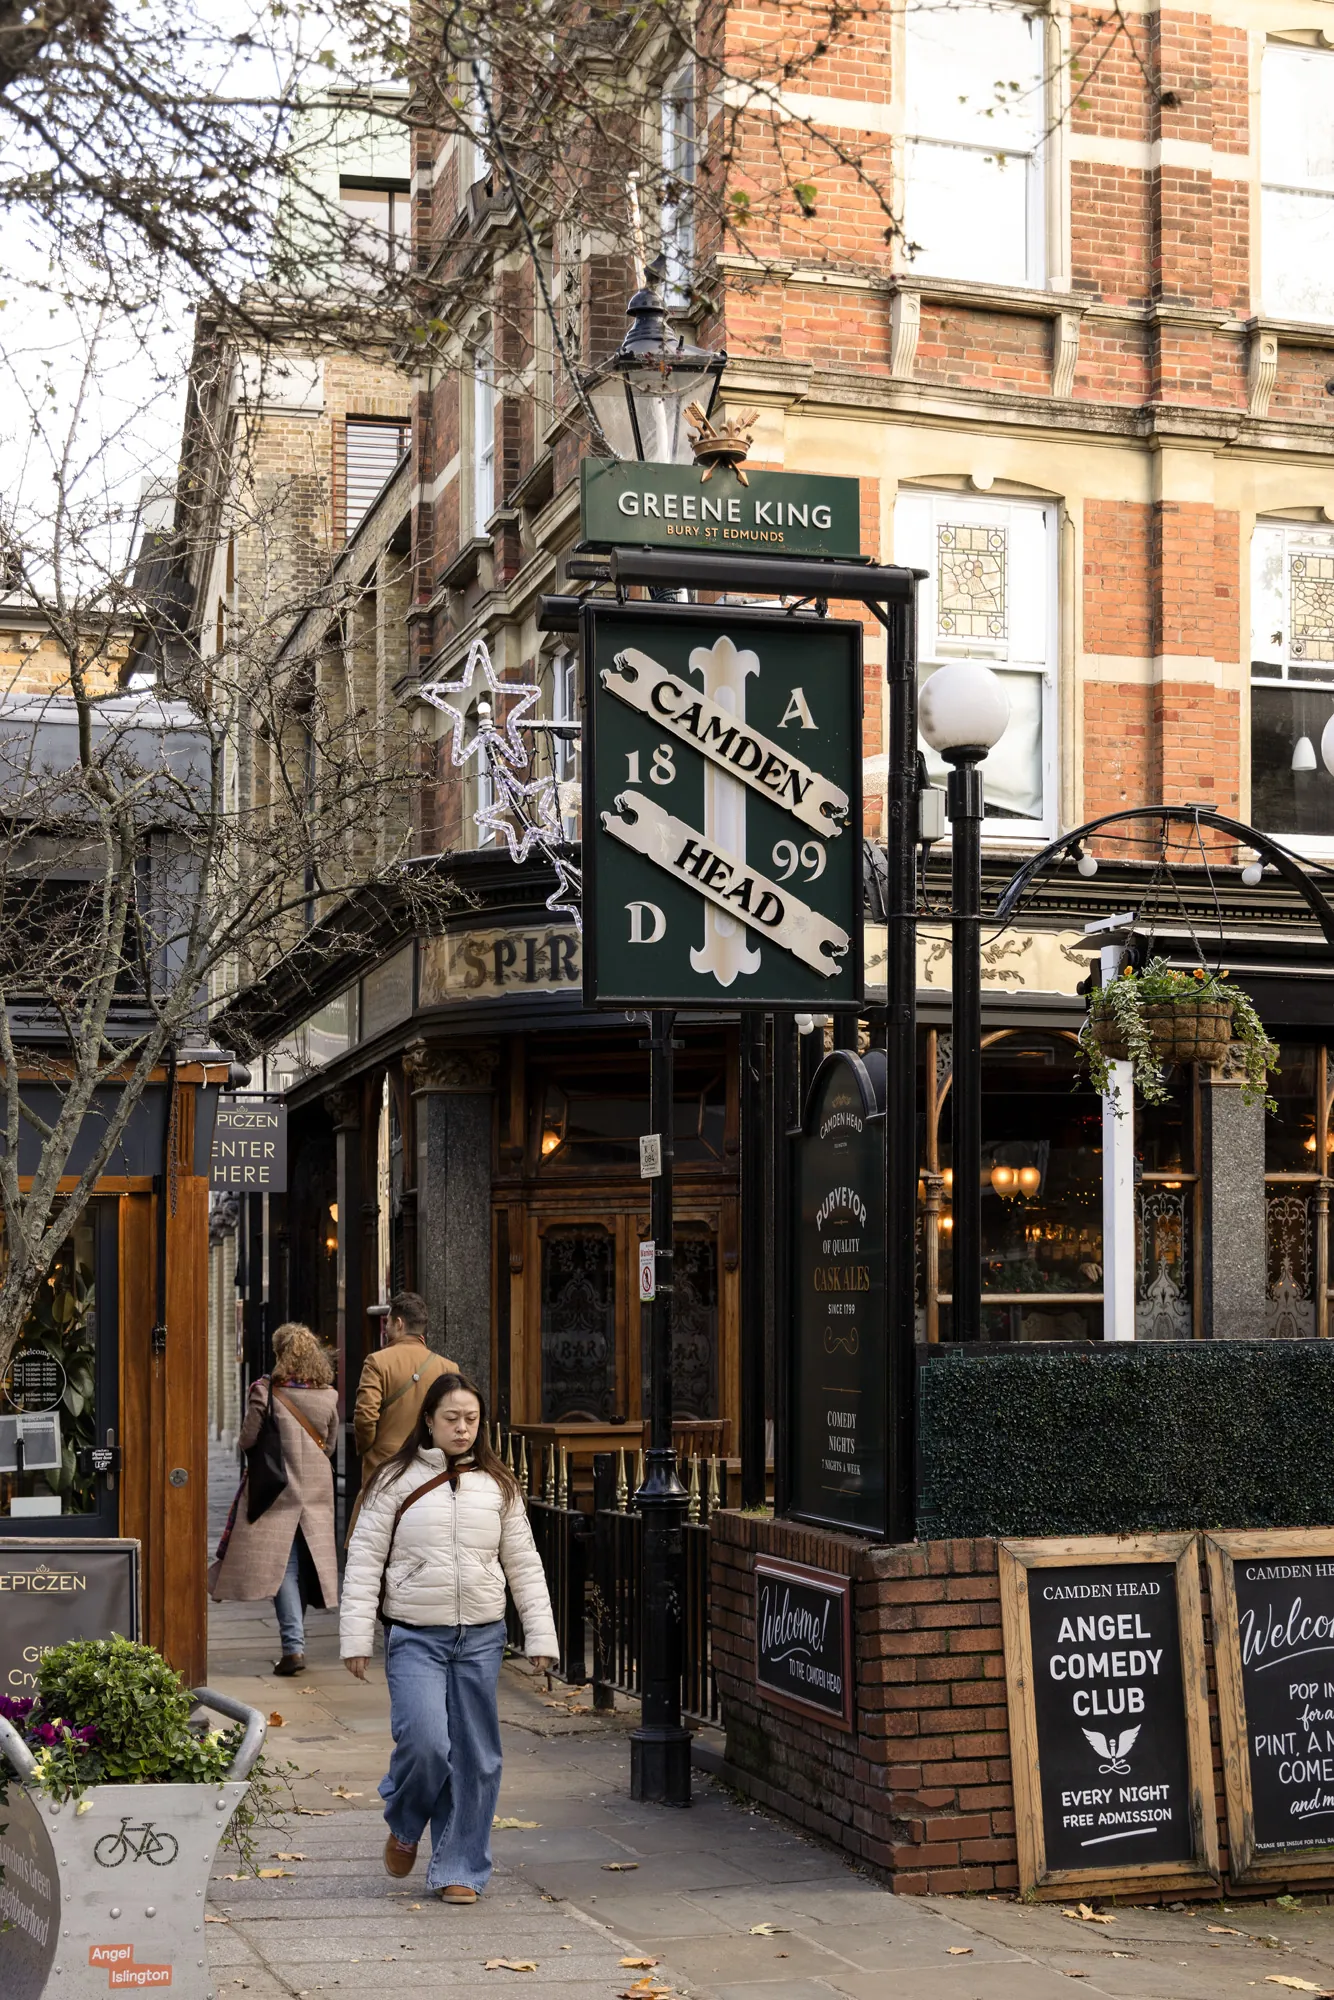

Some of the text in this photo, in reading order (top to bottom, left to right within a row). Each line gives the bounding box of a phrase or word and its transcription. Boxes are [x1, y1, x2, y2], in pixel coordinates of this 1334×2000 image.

[618, 490, 832, 530] GREENE KING
[666, 524, 785, 543] BURY ST EDMUNDS
[777, 687, 820, 730] A
[650, 680, 815, 806] CAMDEN
[624, 743, 676, 786] 18
[772, 839, 827, 883] 99
[673, 839, 785, 928] HEAD
[624, 900, 667, 944] D
[217, 1114, 278, 1128] PICZEN
[820, 1112, 863, 1140] CAMDEN HEAD
[211, 1140, 275, 1158] ENTER
[214, 1165, 270, 1183] HERE
[815, 1186, 867, 1232] PURVEYOR
[822, 1238, 860, 1256] OF QUALITY
[814, 1265, 870, 1292] CASK ALES
[828, 1304, 843, 1314] SINCE
[18, 1348, 51, 1360] Welcome
[827, 1410, 857, 1429] COMEDY
[828, 1435, 855, 1455] NIGHTS
[825, 1459, 842, 1473] NIGHTS
[846, 1463, 861, 1476] WEEK
[0, 1575, 86, 1591] EPICZEN
[1245, 1566, 1312, 1582] CAMDEN
[1042, 1582, 1161, 1600] CAMDEN HEAD
[760, 1584, 830, 1654] Welcome!
[1057, 1614, 1151, 1643] ANGEL
[788, 1658, 842, 1694] TO THE CAMDEN HEAD
[1049, 1648, 1164, 1681] COMEDY
[8, 1669, 41, 1689] Cry
[1289, 1682, 1319, 1700] POP
[1072, 1686, 1146, 1717] CLUB
[1296, 1704, 1324, 1732] for
[1254, 1732, 1300, 1757] PINT,
[1307, 1731, 1322, 1754] A
[1278, 1758, 1334, 1784] COME
[1061, 1784, 1170, 1807] EVERY NIGHT
[1290, 1787, 1321, 1815] and
[1062, 1808, 1173, 1828] FREE ADMISSION
[29, 1858, 51, 1902] Green
[92, 1946, 131, 1962] Angel
[112, 1969, 169, 1984] Islington
